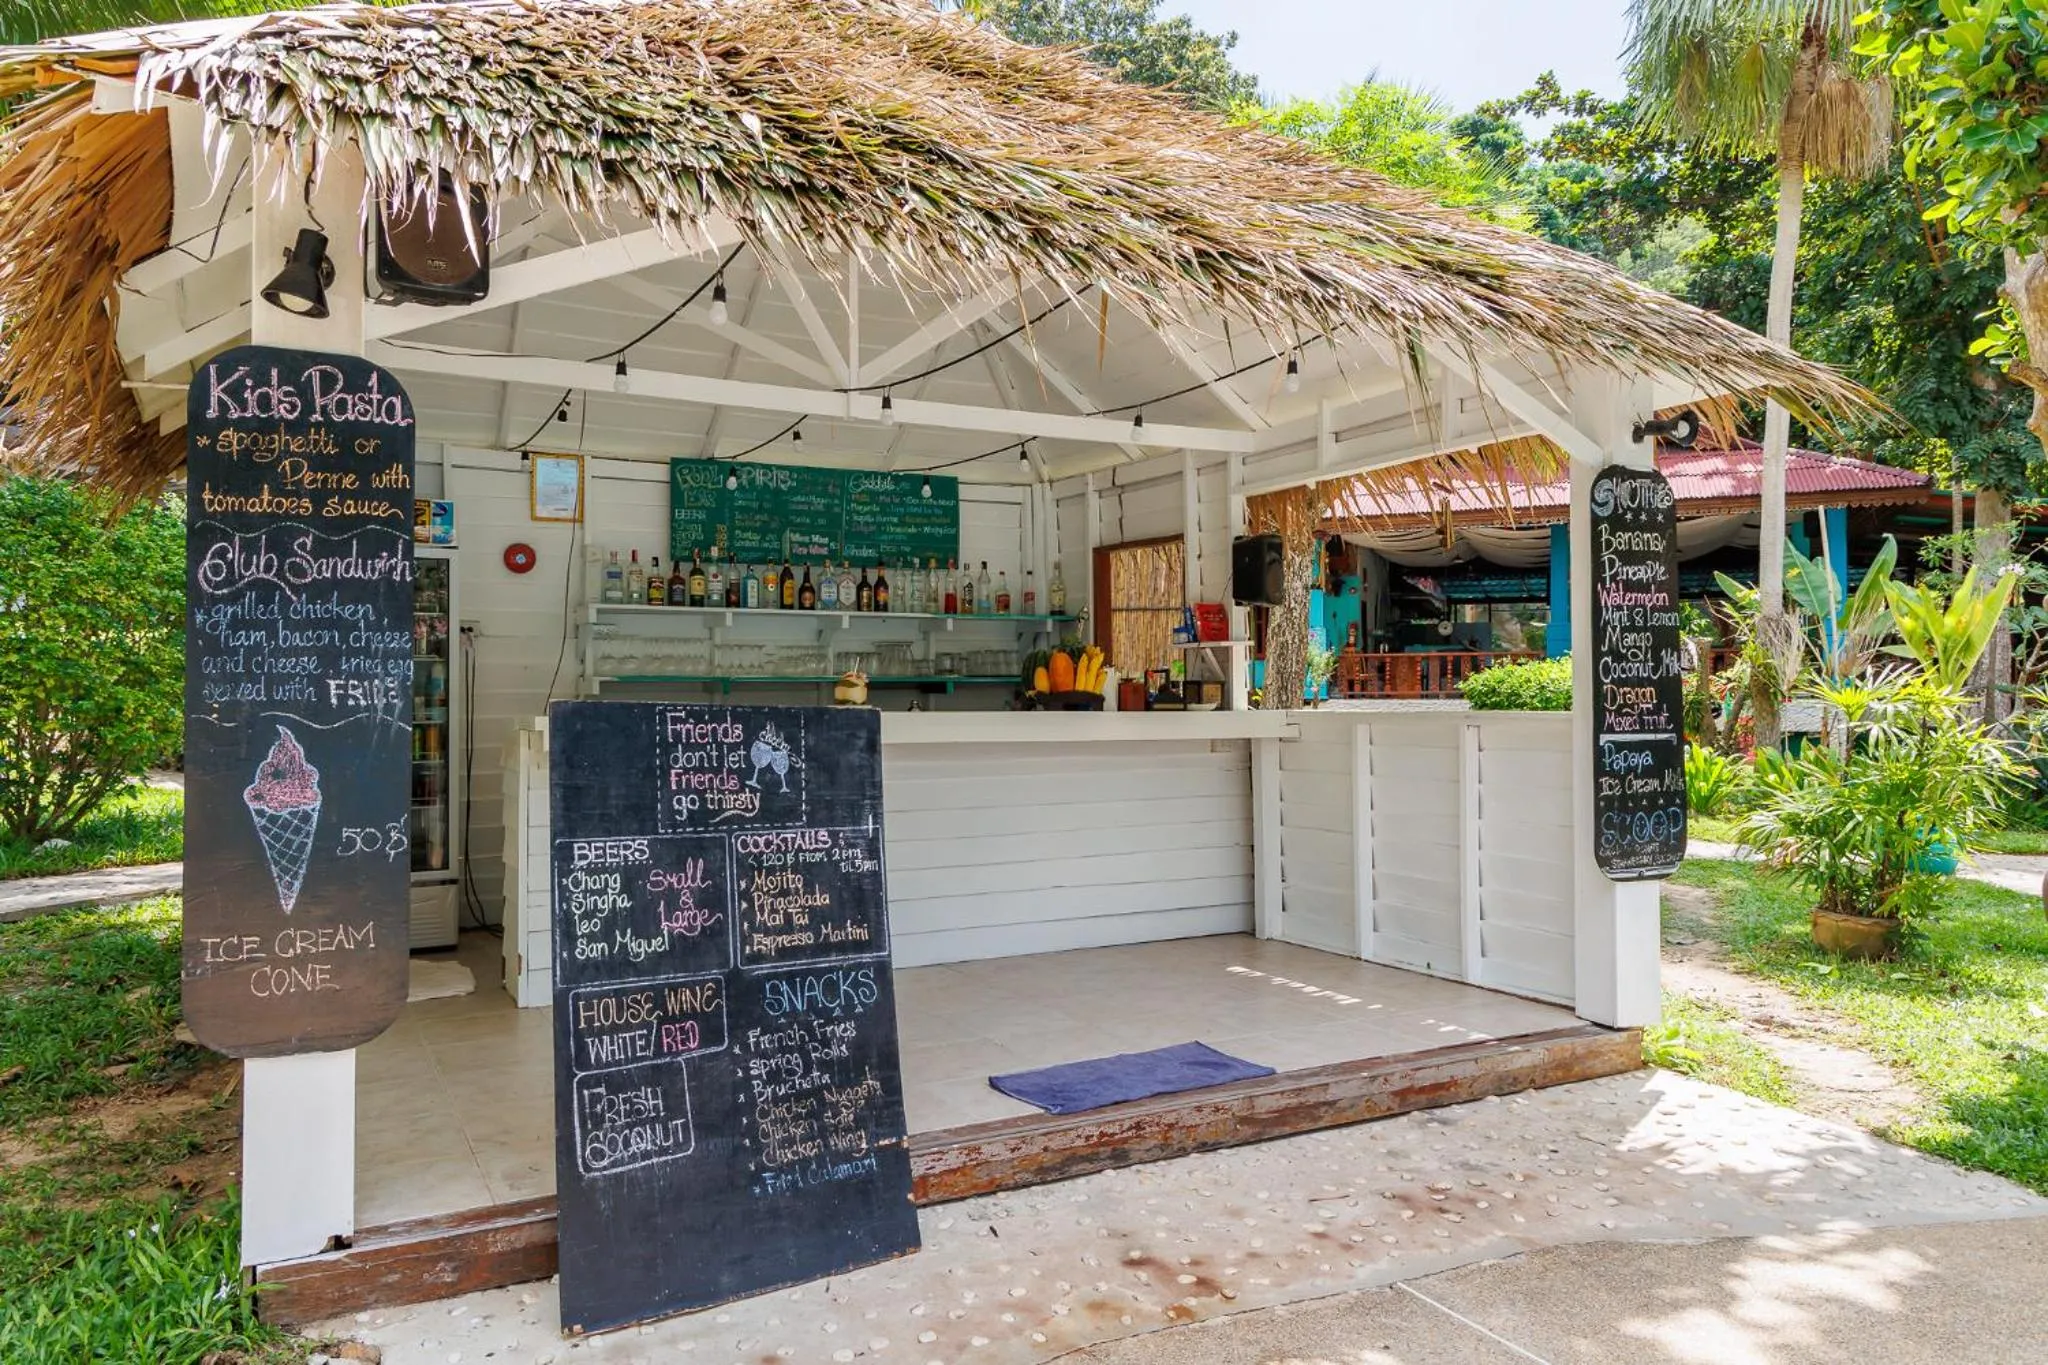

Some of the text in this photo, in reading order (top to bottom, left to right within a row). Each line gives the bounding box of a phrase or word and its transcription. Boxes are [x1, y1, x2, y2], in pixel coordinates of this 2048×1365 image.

[205, 364, 414, 426] Kids Pasta
[217, 424, 381, 462] spaghetti or
[278, 458, 411, 490] Penne with
[202, 481, 313, 516] tomatoes
[1598, 523, 1666, 556] Banana
[197, 533, 288, 598] Club
[1597, 581, 1669, 608] Watermelon
[205, 592, 282, 634] grilled
[1601, 605, 1630, 627] Mint
[1632, 608, 1644, 627] &
[1601, 624, 1653, 662] Mango
[201, 648, 246, 674] and
[1599, 653, 1662, 683] Coconut
[273, 676, 318, 702] with
[1603, 684, 1658, 713] Dragon
[666, 710, 744, 743] Friends
[669, 744, 747, 768] don't let
[1602, 742, 1654, 775] Papaya
[669, 768, 740, 791] Friends
[1625, 772, 1662, 794] Cream
[672, 788, 761, 822] go thirsty
[573, 839, 649, 865] BEERS
[568, 870, 621, 893] Chang
[646, 856, 713, 891] Small
[750, 869, 804, 894] Mojito
[571, 890, 633, 917] Singha
[657, 900, 724, 937] Large
[200, 921, 376, 962] ICE CREAM
[575, 928, 670, 962] San Miguel
[752, 919, 869, 956] Espresso Martini
[251, 963, 340, 997] CONE
[764, 968, 878, 1016] SNACKS
[578, 991, 663, 1029] HOUSE
[661, 1020, 701, 1053] RED
[747, 1019, 857, 1052] French Fries
[807, 1037, 850, 1061] Rolls
[583, 1086, 664, 1129] FRESH
[755, 1097, 818, 1123] Chicken
[584, 1119, 687, 1168] COCONUT
[758, 1119, 818, 1143] Chicken
[763, 1138, 824, 1167] Chicken
